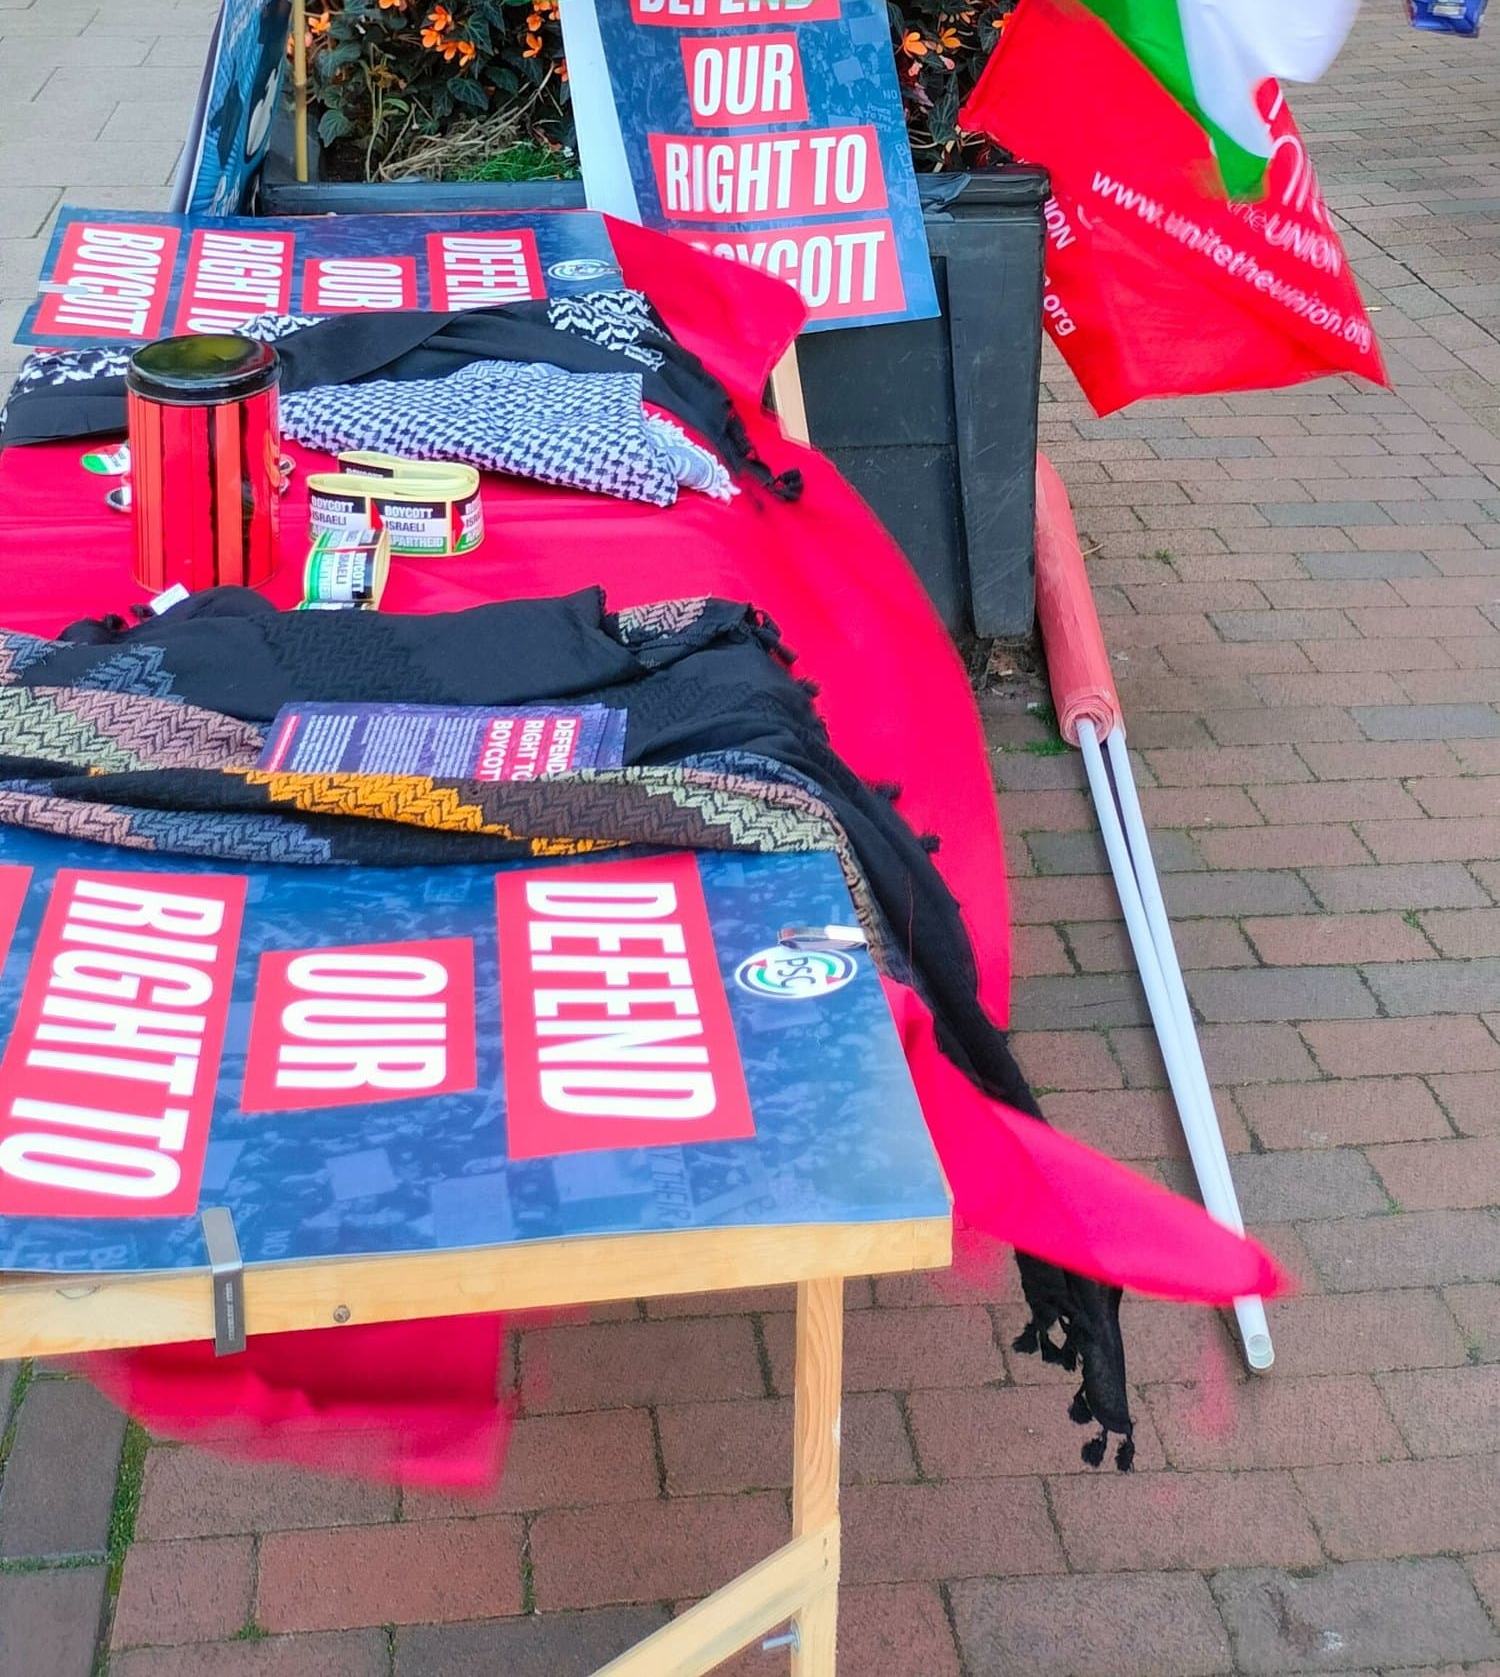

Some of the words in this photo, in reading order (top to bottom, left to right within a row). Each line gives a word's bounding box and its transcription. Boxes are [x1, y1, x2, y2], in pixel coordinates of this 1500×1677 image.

[693, 43, 794, 117] OUR
[665, 139, 800, 214] RIGHT
[809, 134, 867, 206] TO
[55, 227, 165, 335] BOYCOTT
[194, 233, 284, 307] RIGHT
[318, 260, 403, 308] OUR
[442, 237, 531, 311] DEFEN
[688, 231, 885, 308] COTT
[311, 494, 354, 512] BOYCOTT
[312, 511, 347, 525] ISRAELI
[384, 505, 433, 519] BOYCOTT
[385, 520, 425, 532] ISRAELI
[391, 537, 443, 548] PARTHEID
[517, 720, 545, 760] RIGHT
[546, 719, 576, 773] DEFEND
[26, 879, 225, 1096] RIGHT
[275, 953, 449, 1091] OUR
[526, 881, 717, 1120] DEFEND
[0, 1098, 190, 1199] TO
